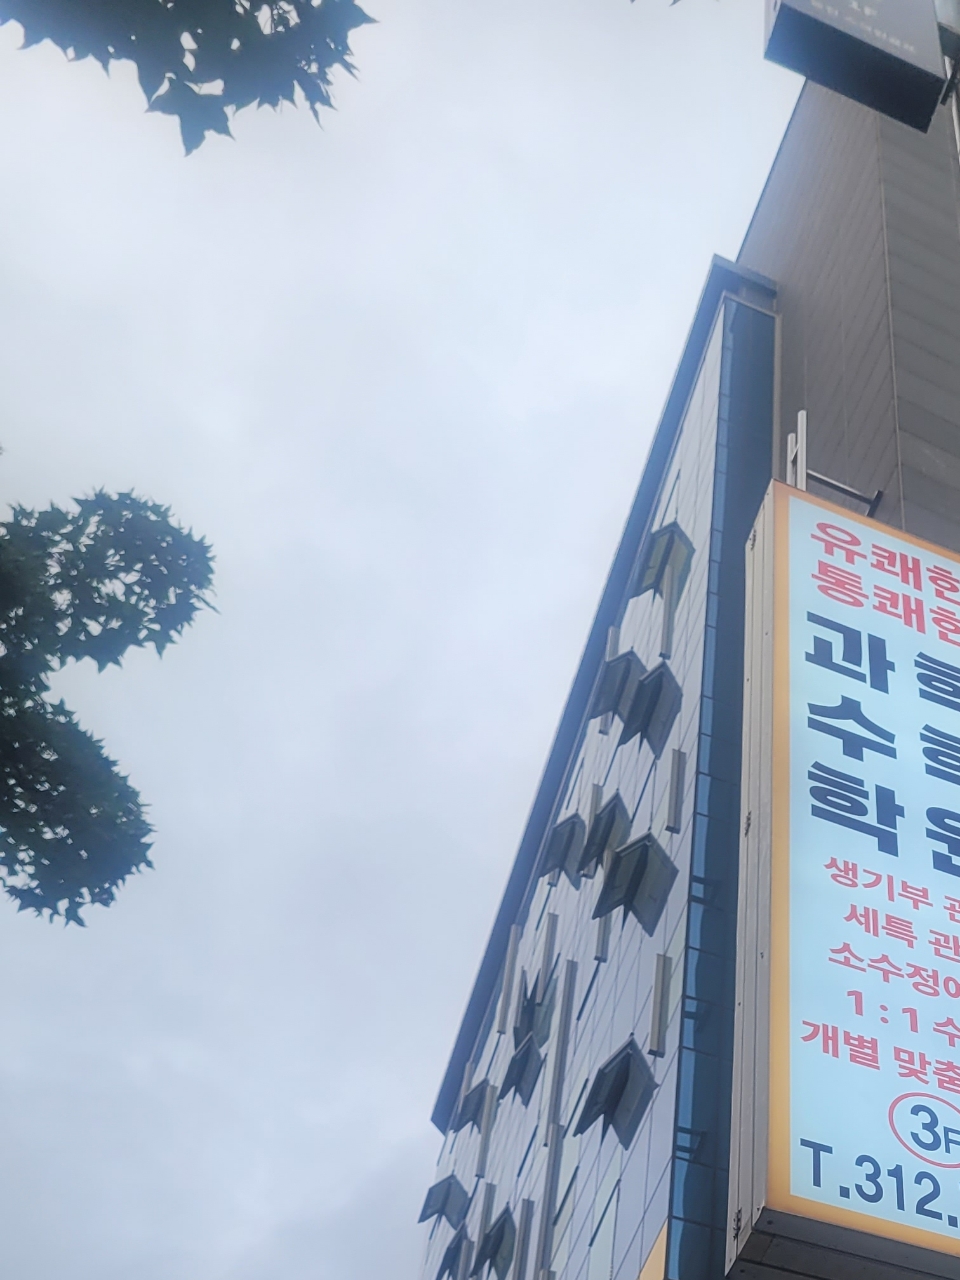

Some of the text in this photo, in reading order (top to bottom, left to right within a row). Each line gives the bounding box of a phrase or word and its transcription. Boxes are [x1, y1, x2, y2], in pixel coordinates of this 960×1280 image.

[823, 856, 931, 910] 생기부
[844, 904, 917, 948] 세특
[800, 1020, 880, 1070] 개별
